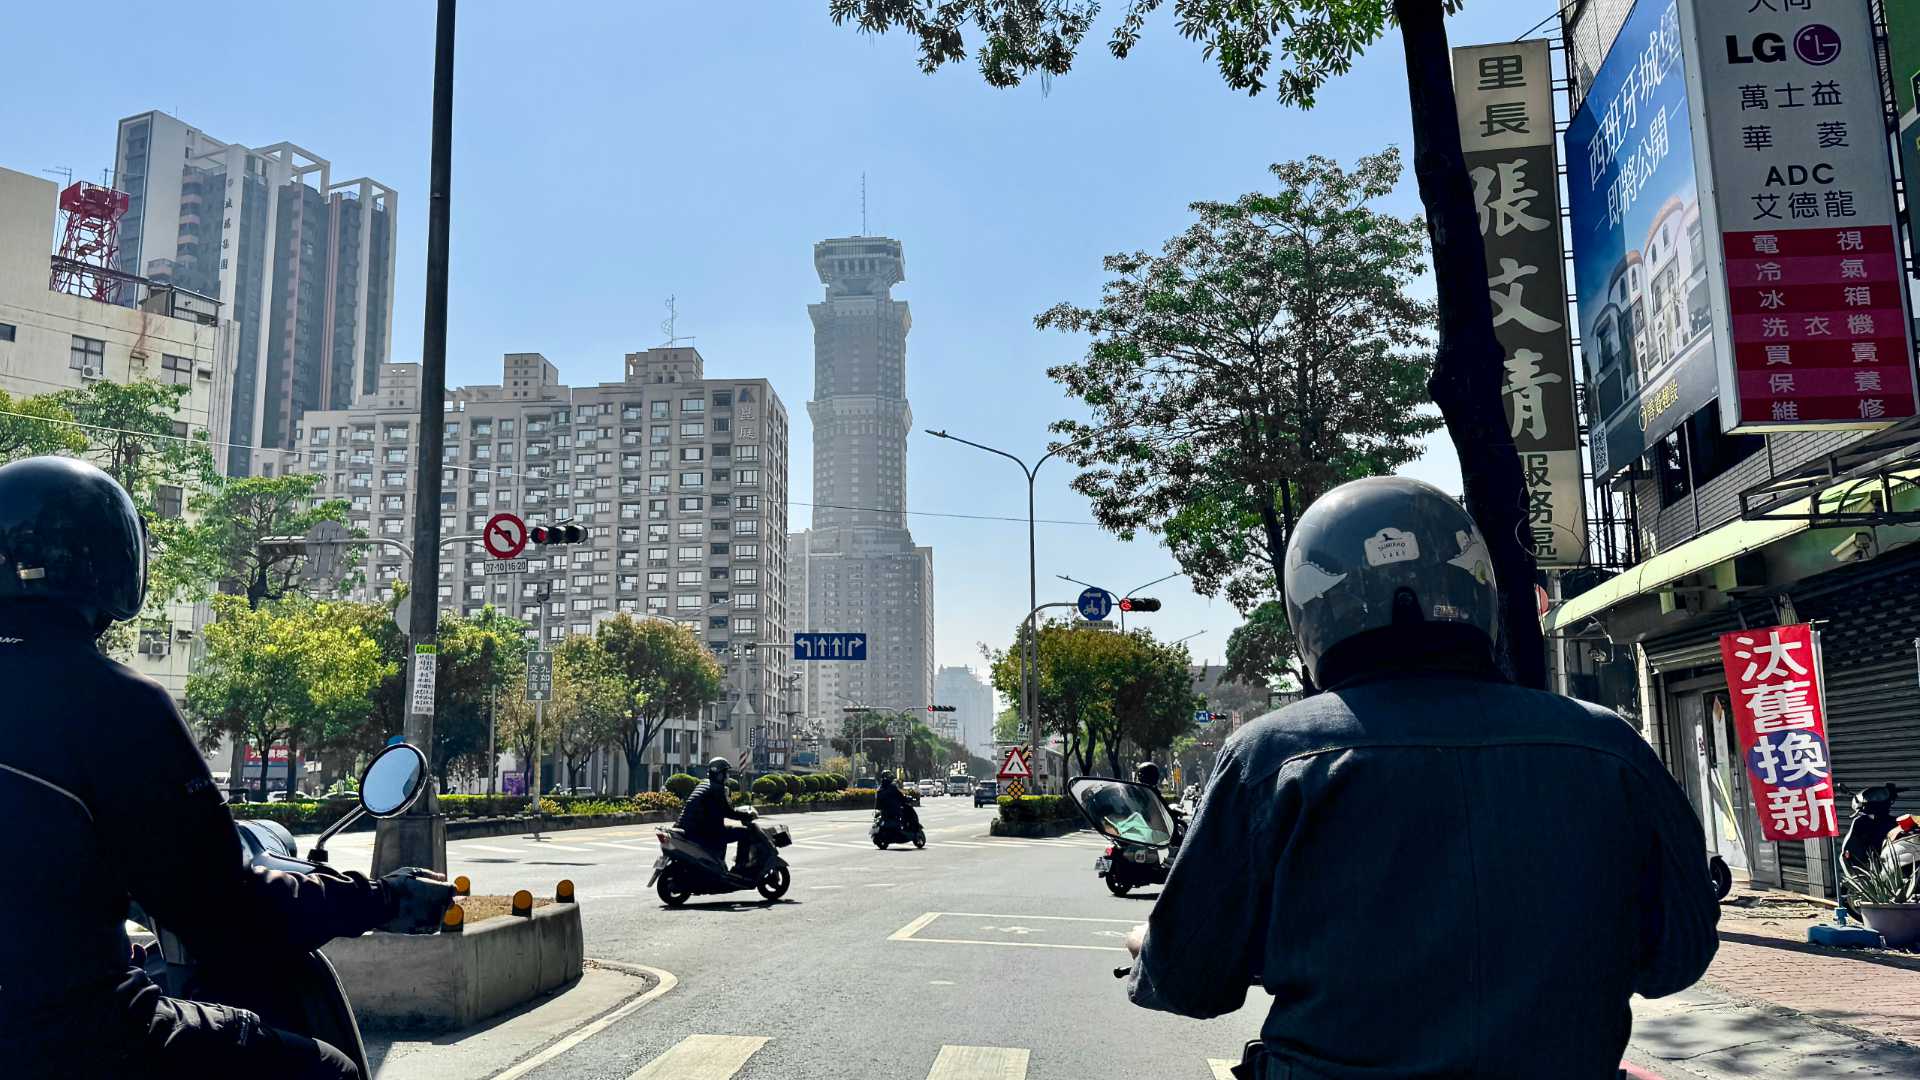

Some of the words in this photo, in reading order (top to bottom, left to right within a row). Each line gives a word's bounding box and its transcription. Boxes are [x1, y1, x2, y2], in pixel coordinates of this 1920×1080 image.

[1726, 32, 1787, 64] LG
[1477, 54, 1530, 138] 里長
[1588, 1, 1682, 191] 西班牙城堡
[1738, 80, 1843, 111] 萬士益
[1742, 121, 1849, 151] 華菱
[1607, 104, 1669, 230] 即將公開
[1765, 163, 1835, 186] ADC
[1751, 190, 1856, 220] 艾德龍
[1752, 231, 1864, 254] 電視
[1755, 259, 1868, 281] 冷氣
[1758, 286, 1871, 310] 冰箱
[1762, 314, 1875, 337] 洗衣機
[1765, 342, 1879, 366] 買賣
[1768, 371, 1882, 394] 保養
[1771, 398, 1885, 421] 維修
[1735, 631, 1836, 836] 汰舊換新
